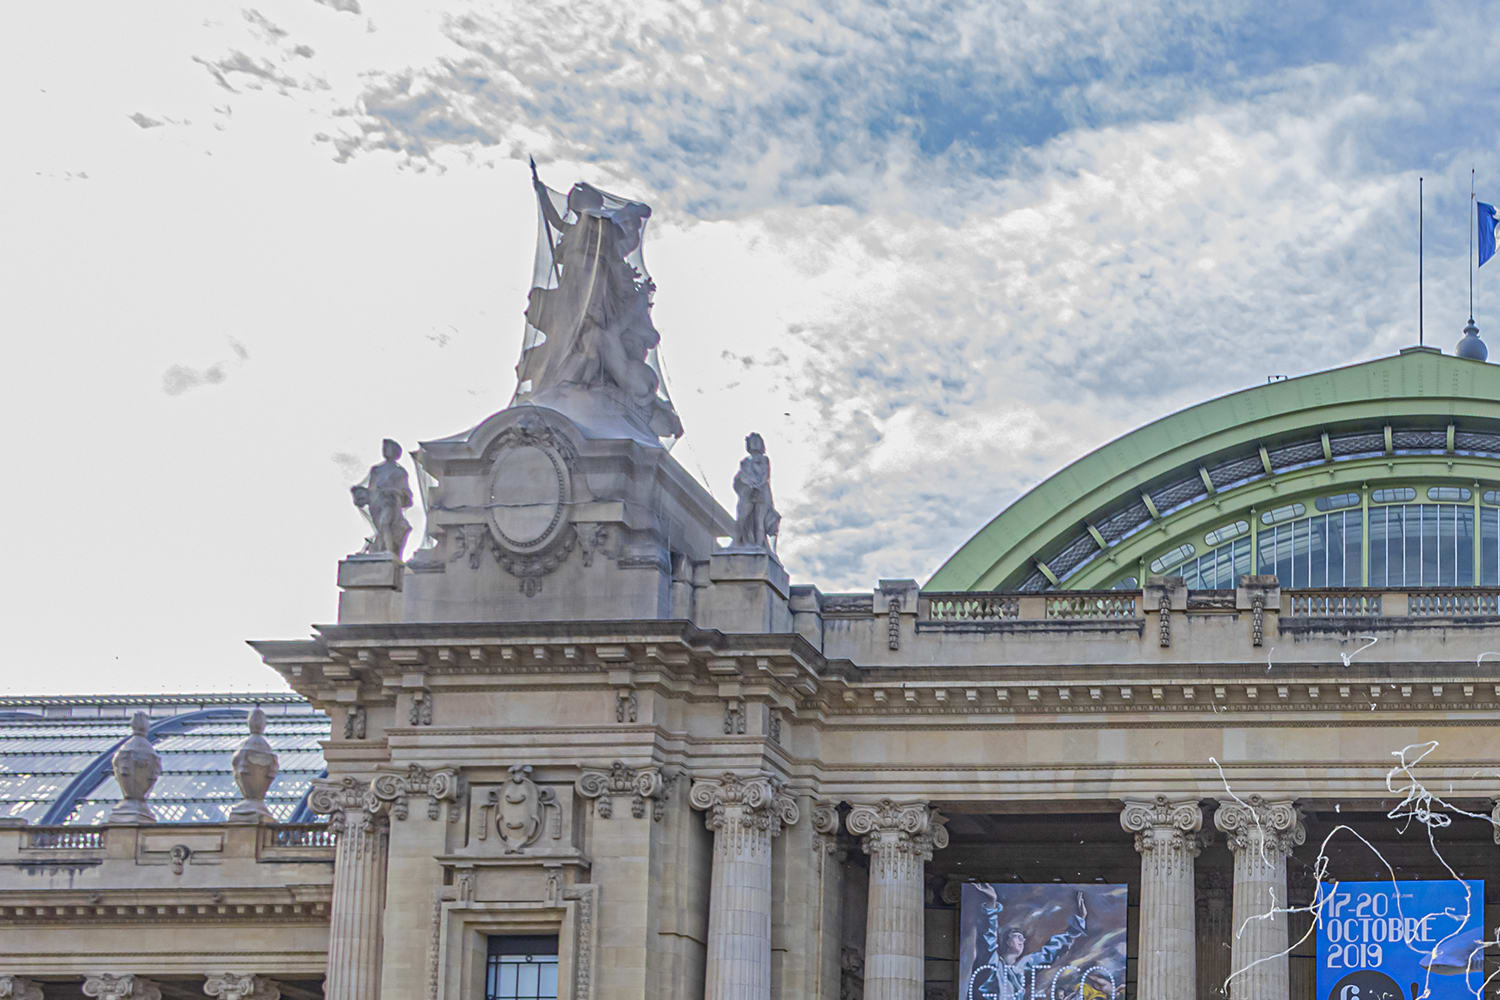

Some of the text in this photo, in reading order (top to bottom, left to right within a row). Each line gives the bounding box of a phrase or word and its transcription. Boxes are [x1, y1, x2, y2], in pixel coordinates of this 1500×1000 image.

[1328, 893, 1388, 917] 17-20
[1327, 918, 1436, 942] OCTOBRE
[1327, 943, 1383, 968] 2019
